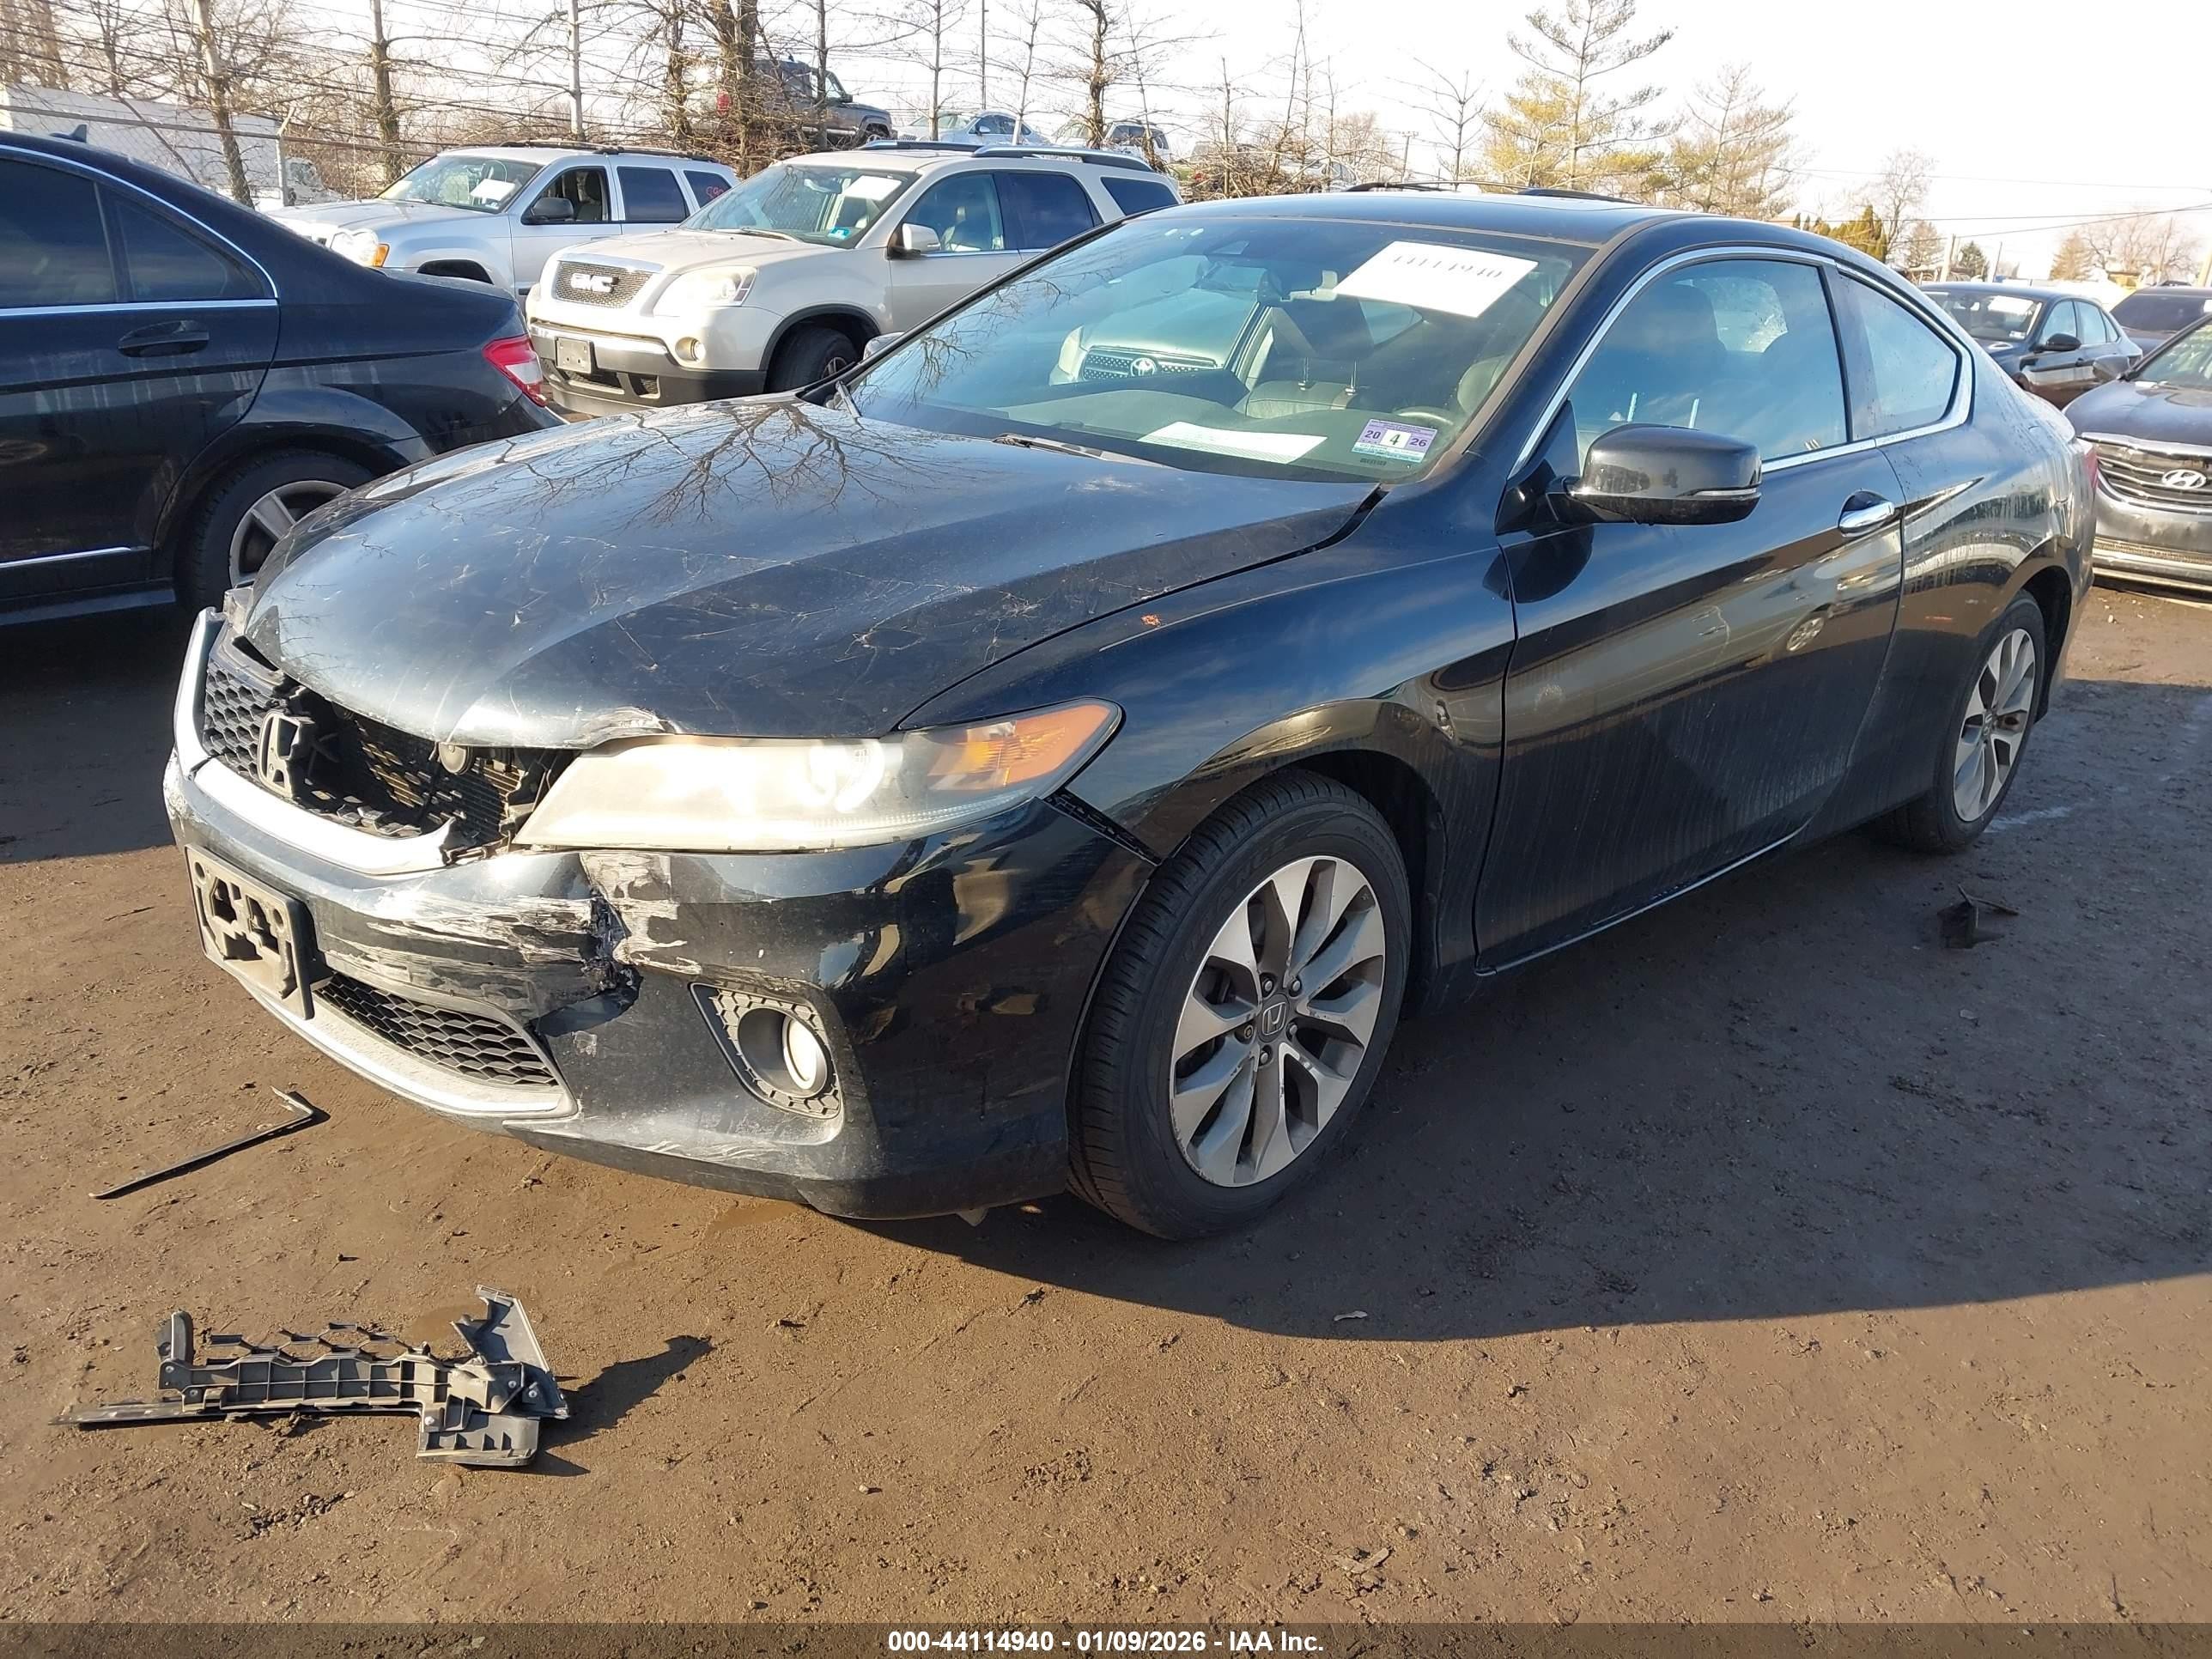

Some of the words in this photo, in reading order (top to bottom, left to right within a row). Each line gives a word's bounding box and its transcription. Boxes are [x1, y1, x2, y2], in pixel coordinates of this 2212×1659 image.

[570, 272, 614, 293] GMC
[1364, 429, 1382, 440] 20
[1389, 433, 1401, 446] 4
[1408, 437, 1428, 447] 26
